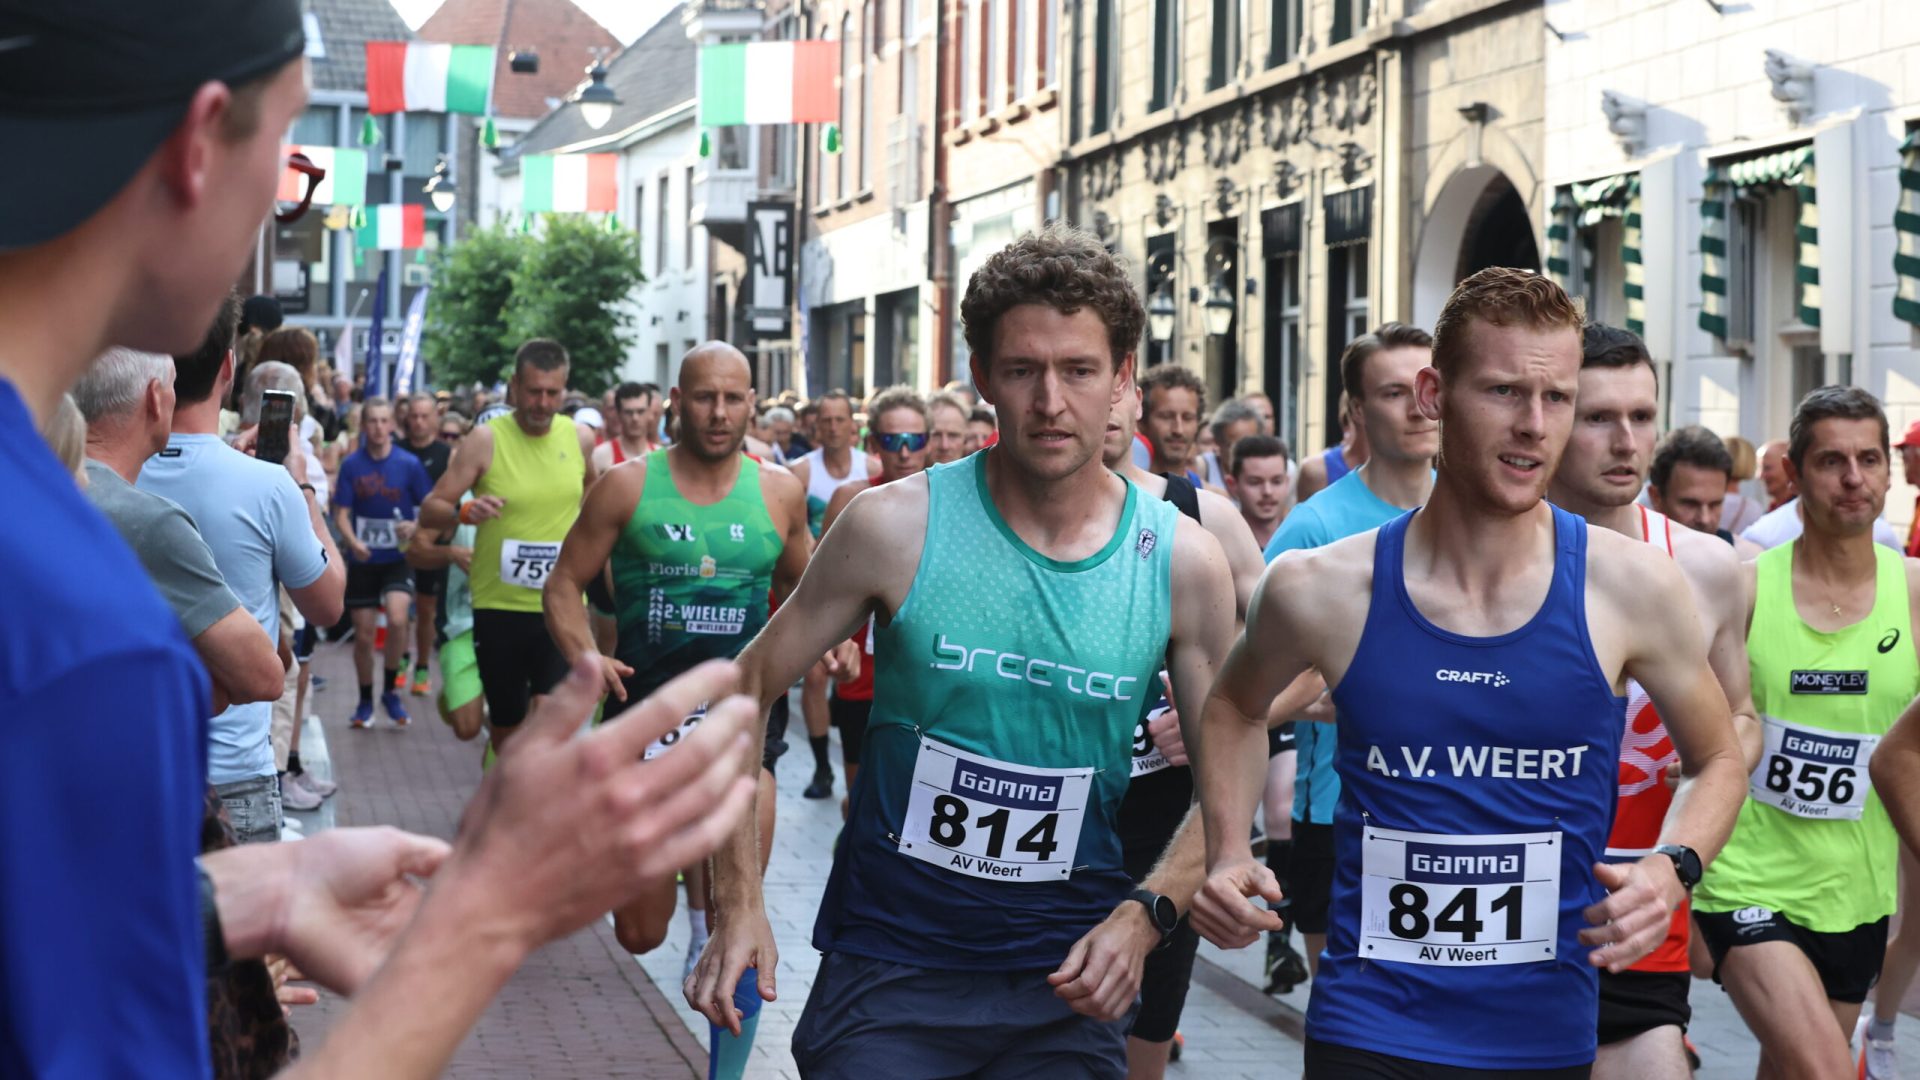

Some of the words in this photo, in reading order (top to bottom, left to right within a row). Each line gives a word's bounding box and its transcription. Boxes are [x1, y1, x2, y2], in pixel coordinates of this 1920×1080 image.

[649, 563, 698, 576] Floris
[664, 604, 746, 623] 2-WIELERS
[1436, 669, 1494, 684] CRAFT
[1366, 745, 1436, 778] A.V.
[1447, 745, 1589, 780] WEERT
[1766, 754, 1857, 805] 856
[1780, 798, 1796, 810] AV
[1797, 803, 1829, 816] Weert
[929, 794, 1059, 862] 814
[950, 854, 973, 870] AV
[976, 861, 1023, 878] Weert
[1388, 883, 1523, 943] 841
[1418, 946, 1443, 961] AV
[1448, 947, 1498, 962] Weert
